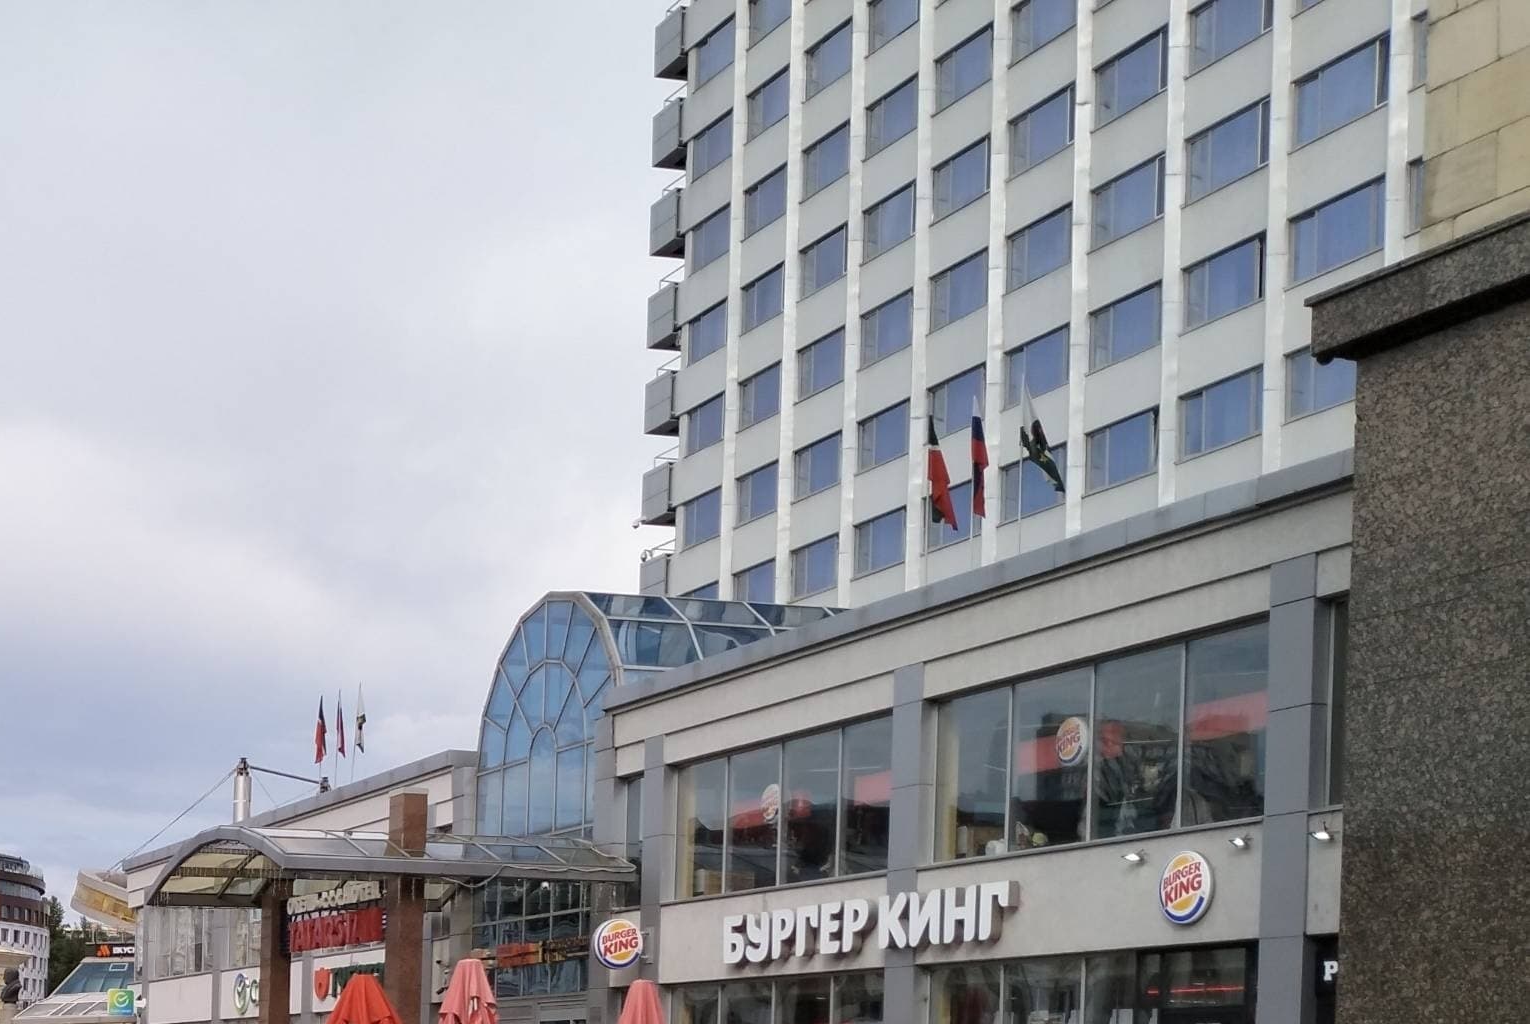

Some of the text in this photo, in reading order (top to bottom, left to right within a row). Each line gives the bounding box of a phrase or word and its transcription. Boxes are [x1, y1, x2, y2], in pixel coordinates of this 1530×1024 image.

[1163, 862, 1201, 891] BURGER
[1164, 874, 1202, 908] KING
[602, 928, 637, 945] BURGER
[723, 880, 1012, 964] БУРГЕР КИНГ
[603, 936, 638, 957] KING
